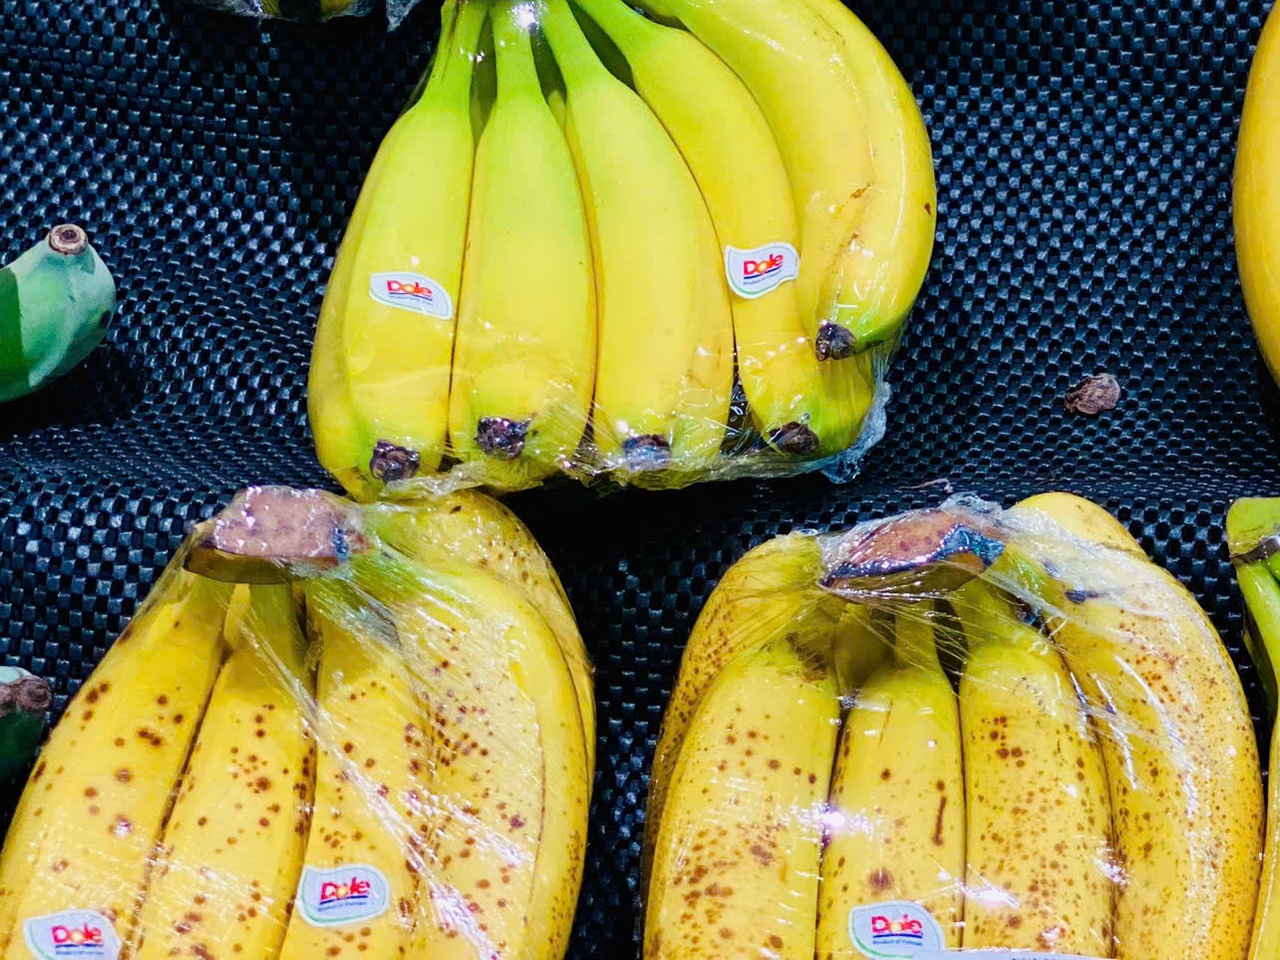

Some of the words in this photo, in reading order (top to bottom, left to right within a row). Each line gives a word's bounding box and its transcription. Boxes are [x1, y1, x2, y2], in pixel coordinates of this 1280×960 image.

[743, 253, 784, 275] Dole
[386, 280, 433, 298] Dole
[320, 876, 371, 900] Dole
[51, 922, 103, 944] Dole
[871, 914, 923, 934] Dole
